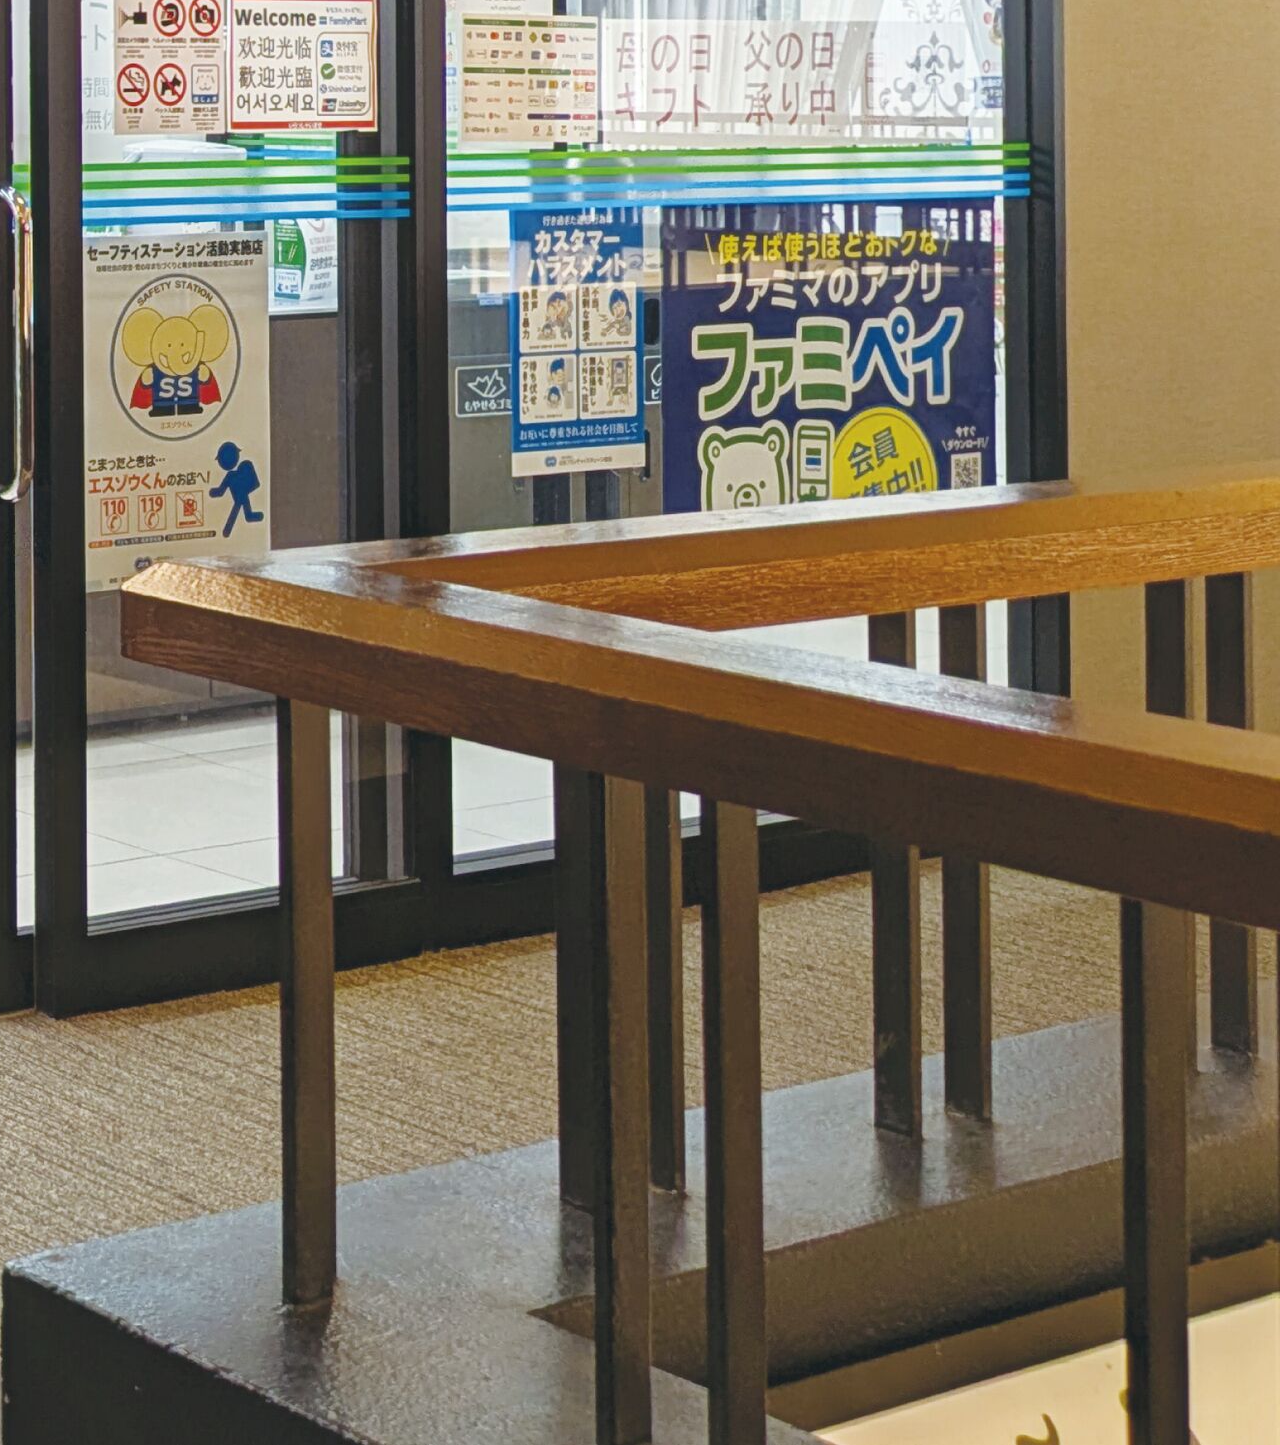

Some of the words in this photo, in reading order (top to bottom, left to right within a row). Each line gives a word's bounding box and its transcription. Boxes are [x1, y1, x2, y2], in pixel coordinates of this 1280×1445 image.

[234, 7, 317, 27] Welcome
[328, 16, 368, 26] FamilyMart
[238, 35, 313, 60] 欢迎光临
[617, 32, 712, 74] 母の日
[743, 30, 834, 73] 父の日
[238, 65, 314, 89] 歡迎光臨
[328, 84, 352, 93] Shinhan
[353, 84, 367, 93] Card
[236, 92, 315, 114] 어서오세요
[743, 81, 836, 128] 承り中
[86, 239, 264, 261] セーフティステーション活動実施店
[534, 229, 621, 254] カスタマー
[715, 227, 939, 265] 使えば使うほどおトクな
[527, 252, 627, 281] ハラスメント
[137, 280, 172, 306] SAFETY
[175, 280, 214, 303] STATION
[714, 259, 943, 313] ファミマのアプリ
[690, 305, 964, 422] ファミペイ
[158, 375, 193, 399] SS
[522, 361, 530, 416] つきまとい
[159, 420, 193, 430] エスゾウくん
[519, 422, 639, 441] お互いに尊重される社会を目指して
[955, 426, 978, 437] 今すぐ
[847, 425, 900, 481] 会員
[88, 472, 211, 494] エスゾウくんのお店へ!
[103, 499, 126, 517] 110
[140, 496, 164, 513] 119
